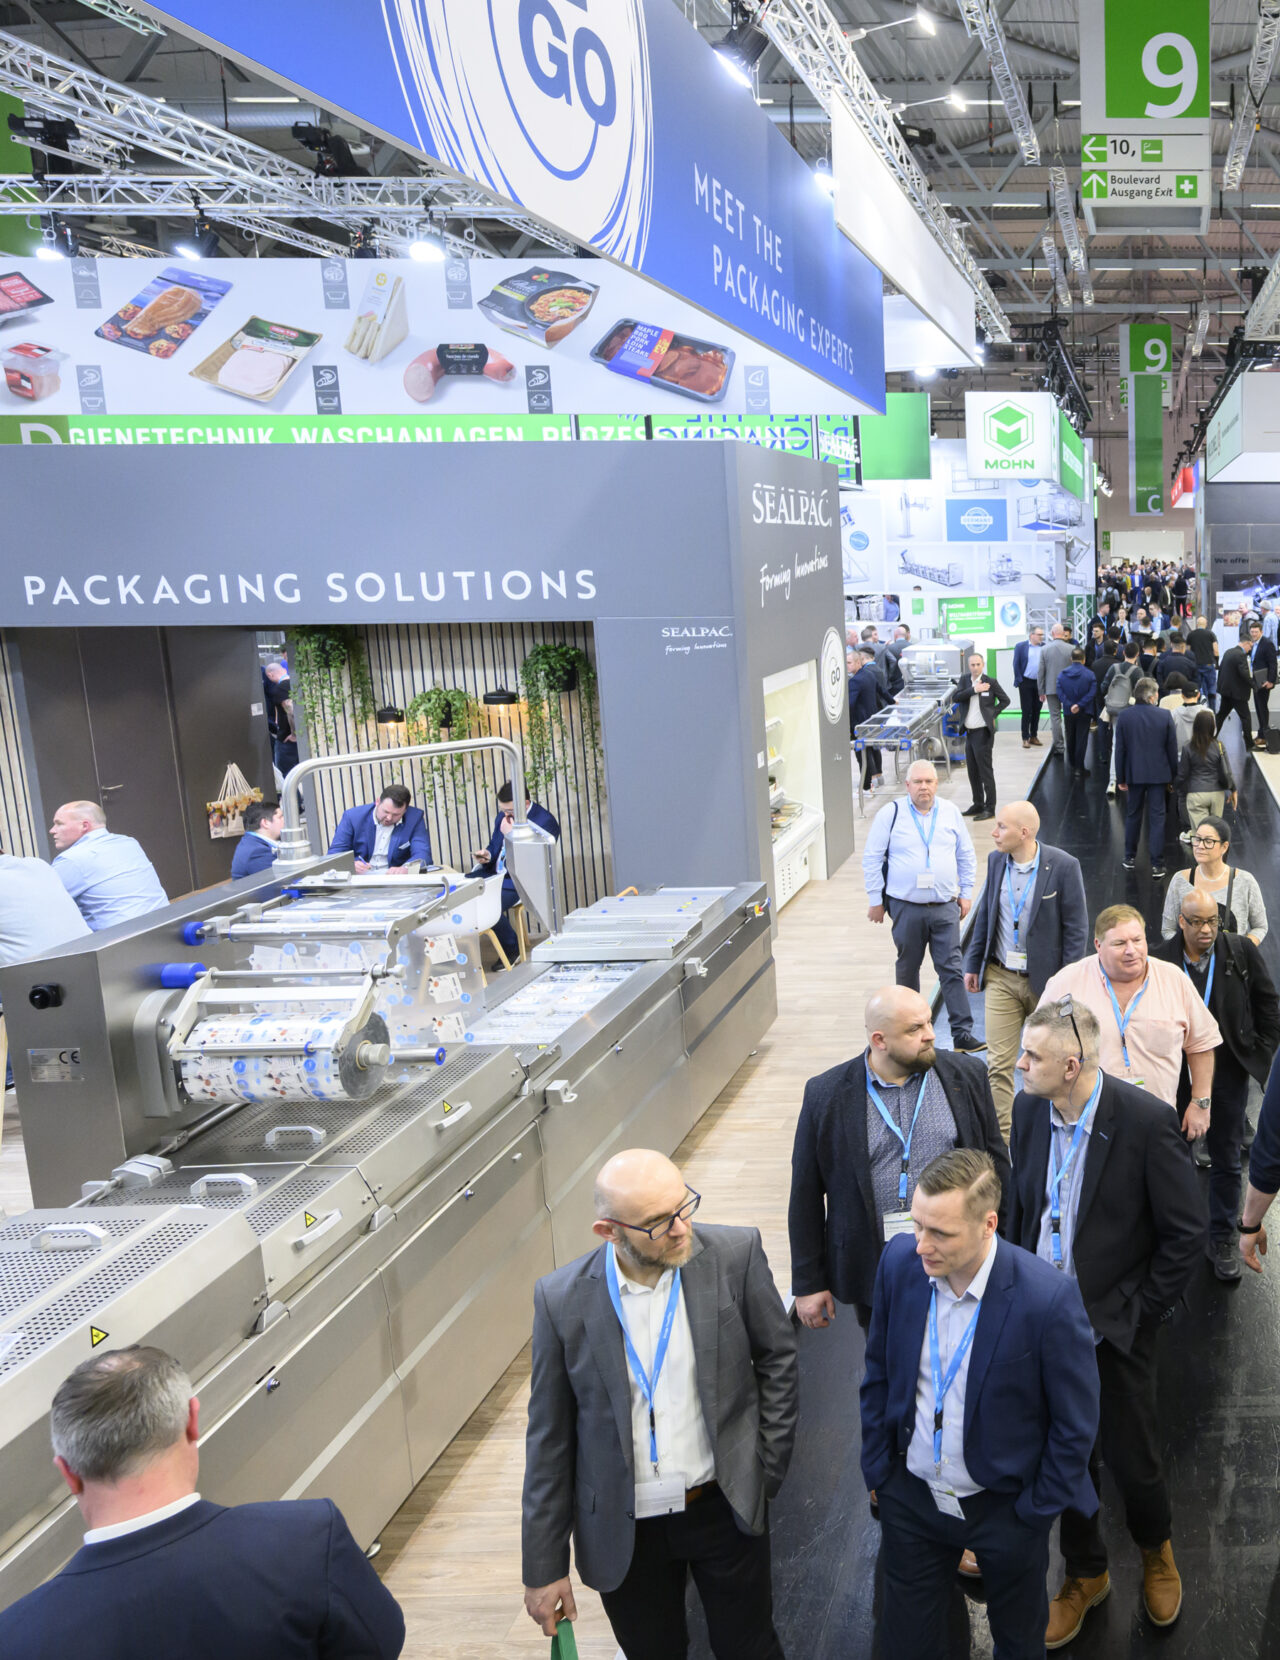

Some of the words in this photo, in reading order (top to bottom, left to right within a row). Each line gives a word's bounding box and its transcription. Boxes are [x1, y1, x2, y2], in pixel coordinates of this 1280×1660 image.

[1142, 32, 1198, 119] 9
[1110, 175, 1160, 184] Boulevard
[1111, 188, 1153, 199] Ausgang
[1155, 188, 1173, 197] Exit
[694, 162, 745, 242] MEET
[753, 215, 783, 274] THE
[713, 243, 806, 343] PACKAGING
[810, 317, 855, 376] EXPERTS
[1144, 338, 1168, 372] 9
[985, 460, 1035, 470] MOHN
[753, 483, 832, 527] SEALPAC
[1148, 494, 1161, 513] C
[24, 573, 301, 606] PACKAGING
[326, 569, 598, 603] SOLUTIONS
[760, 563, 791, 608] Forming
[795, 545, 828, 579] Innovations
[661, 626, 730, 637] SEALPAC
[665, 644, 691, 655] Forming
[694, 641, 728, 650] Innovations
[830, 667, 841, 685] GO
